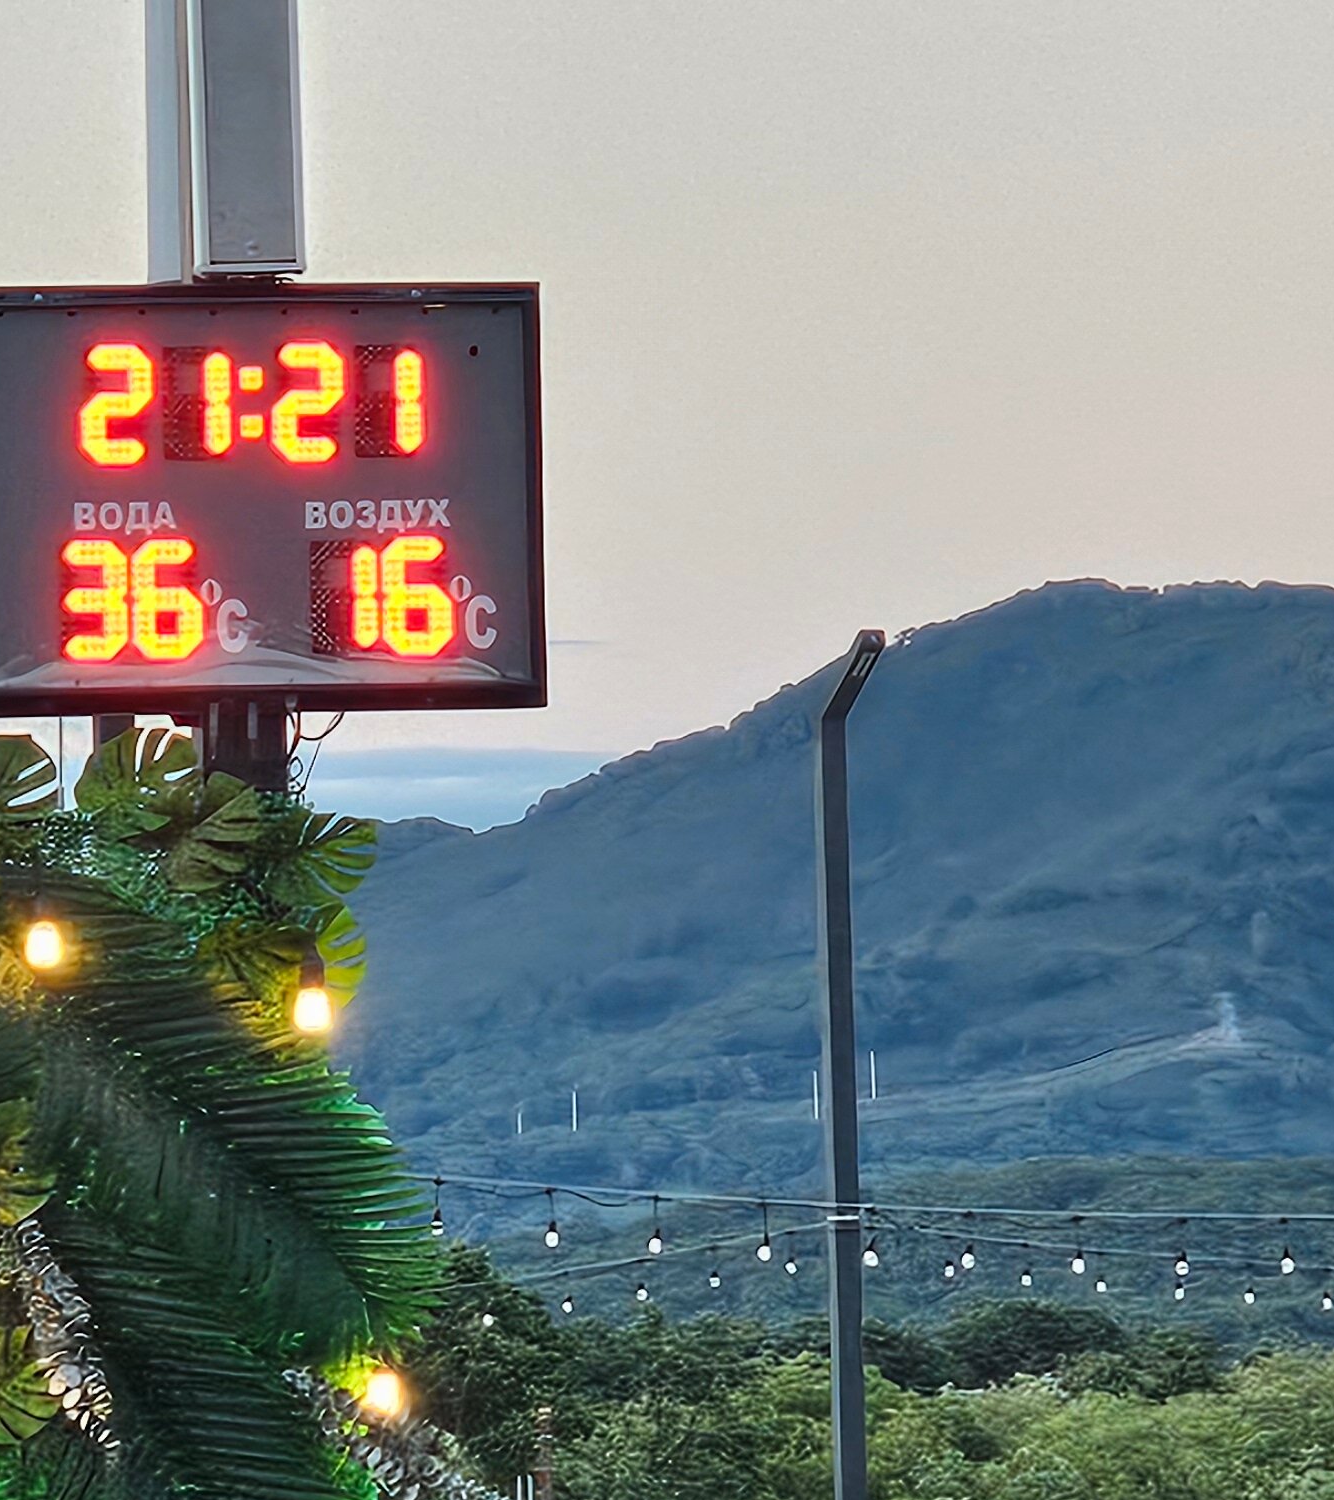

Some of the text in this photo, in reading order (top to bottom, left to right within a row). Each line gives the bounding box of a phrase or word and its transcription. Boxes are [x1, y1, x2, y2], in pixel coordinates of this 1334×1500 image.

[76, 341, 428, 467] 21:21
[73, 501, 177, 536] ВОДА
[304, 498, 451, 534] ВОЗДУХ
